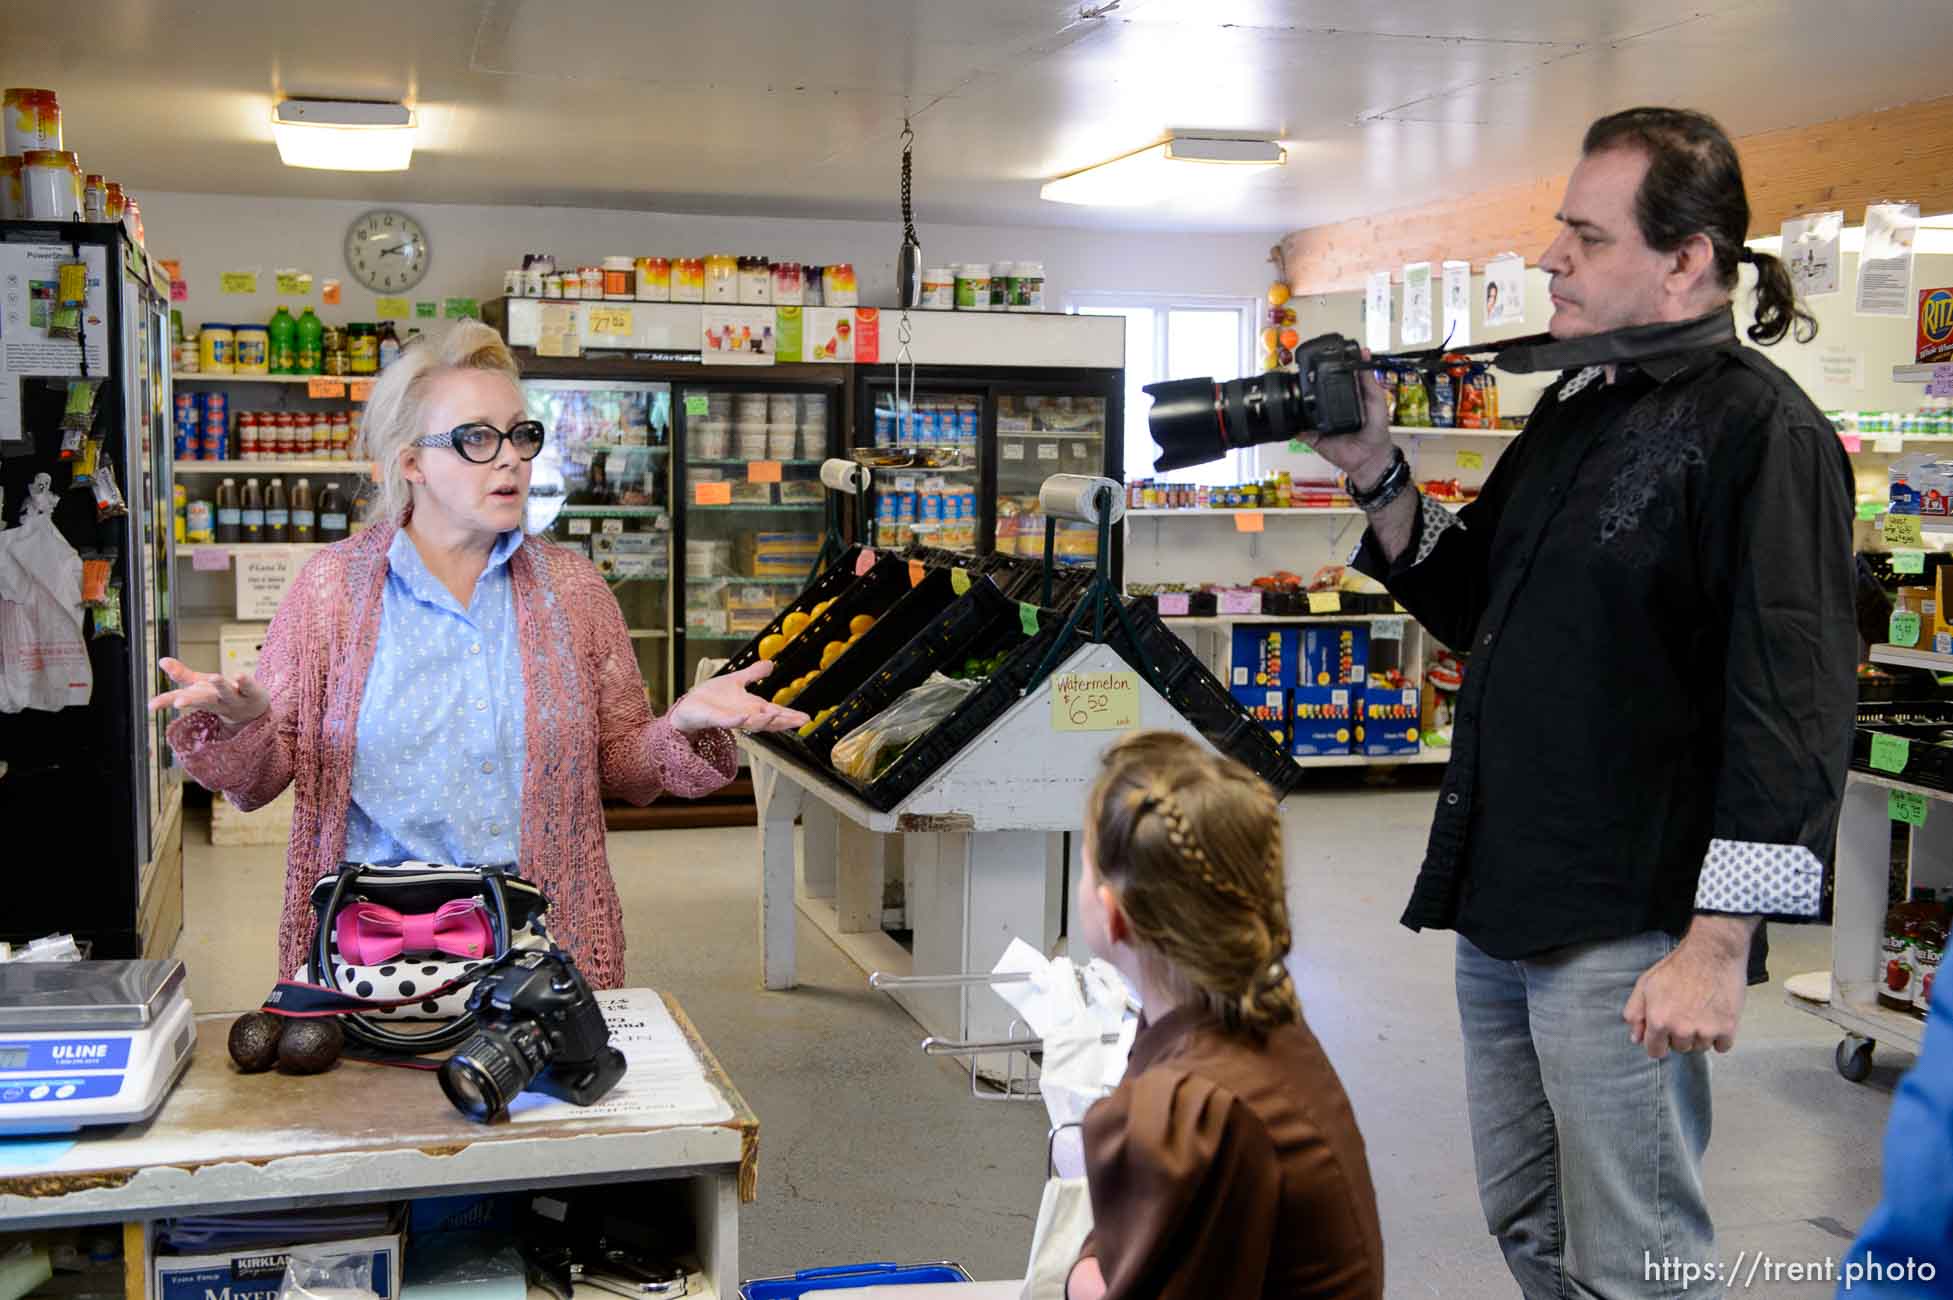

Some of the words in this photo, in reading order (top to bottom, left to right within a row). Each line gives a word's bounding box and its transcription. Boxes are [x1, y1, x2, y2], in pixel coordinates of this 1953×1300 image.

[1924, 297, 1953, 334] RITZ
[1057, 674, 1129, 692] Watermelon
[52, 1044, 108, 1059] ULINE
[237, 1255, 292, 1269] KIRKLA
